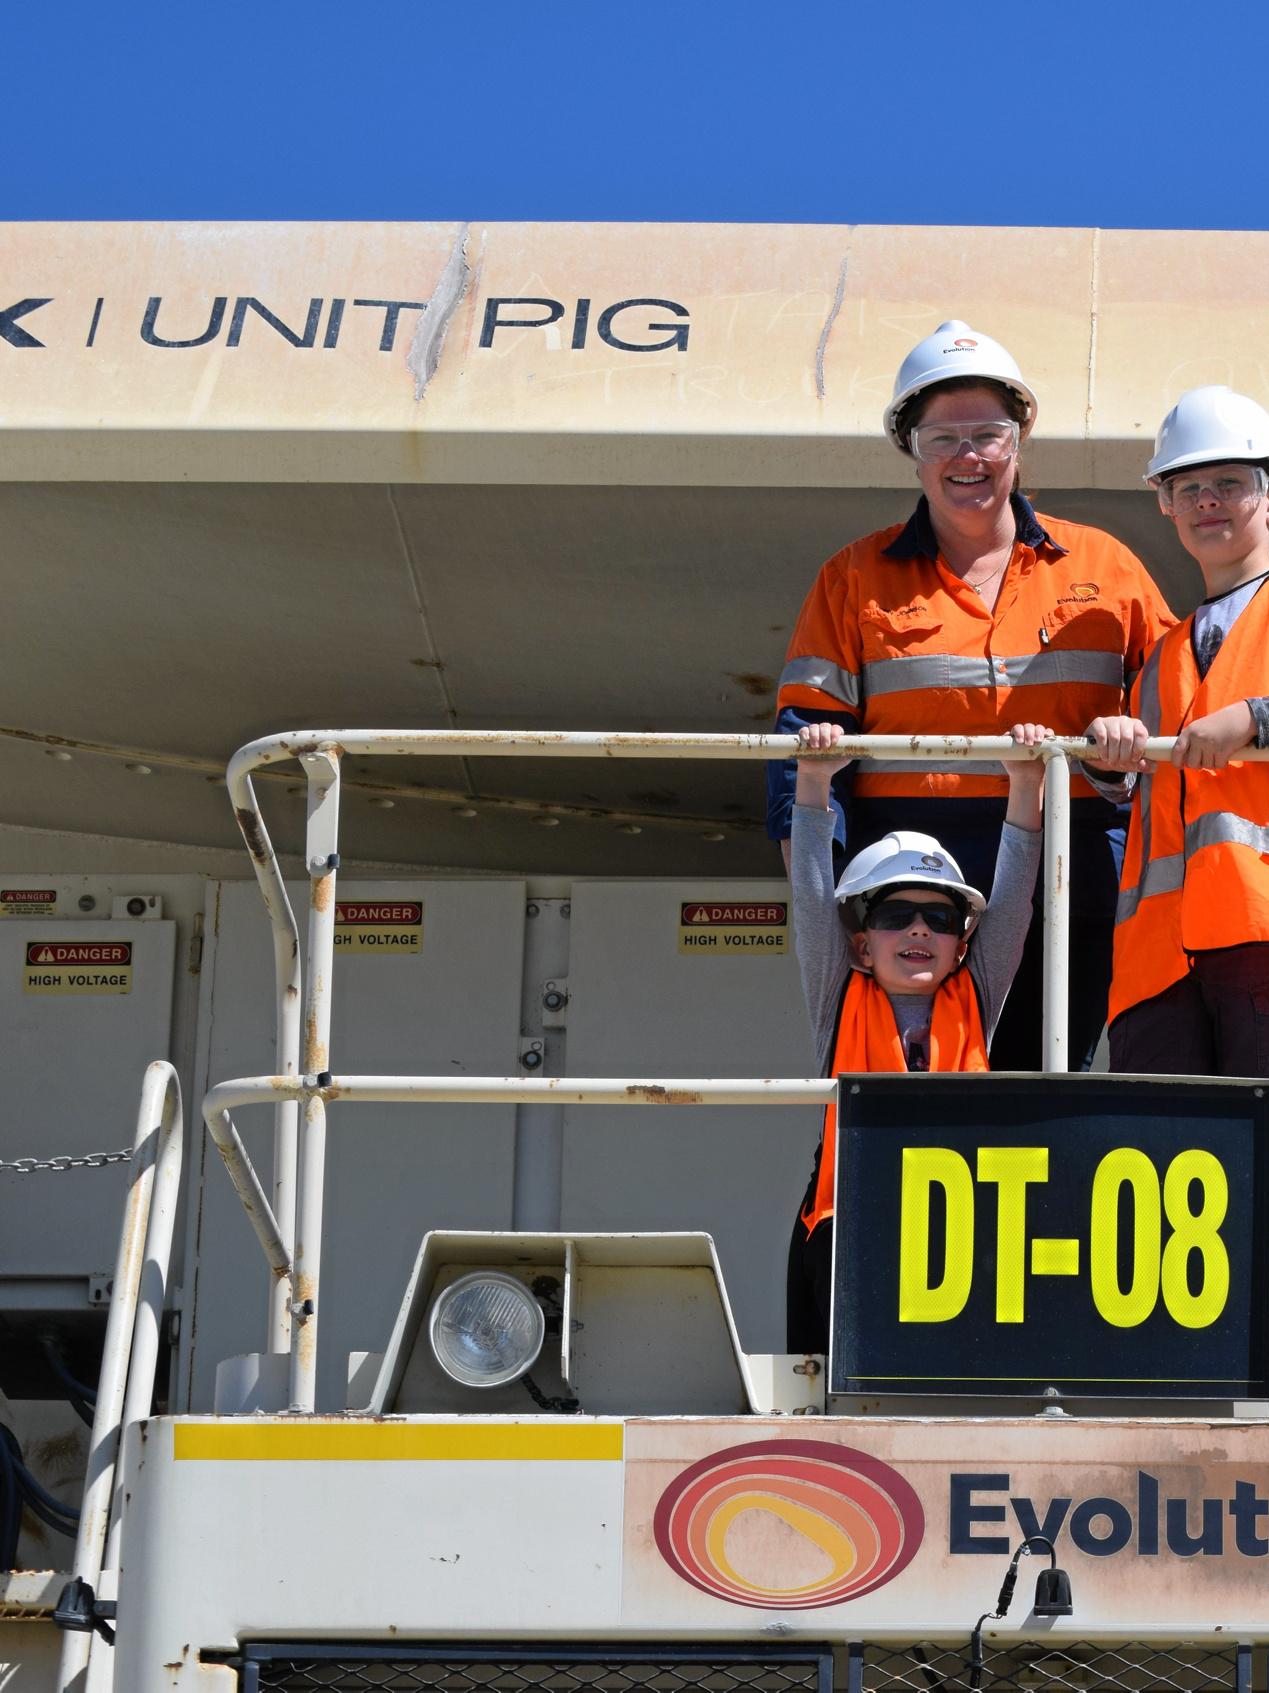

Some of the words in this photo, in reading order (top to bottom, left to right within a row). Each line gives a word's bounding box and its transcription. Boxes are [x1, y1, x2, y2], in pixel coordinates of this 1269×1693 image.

[140, 296, 425, 352] UNIT
[348, 908, 412, 919] DANGER
[712, 908, 777, 920] DANGER
[333, 934, 352, 945] GH
[359, 934, 418, 945] VOLTAGE
[684, 935, 717, 946] HIGH
[723, 935, 784, 946] VOLTAGE
[57, 948, 122, 960] DANGER
[28, 975, 62, 986] HIGH
[68, 975, 128, 986] VOLTAGE
[899, 1147, 1230, 1329] DT-08
